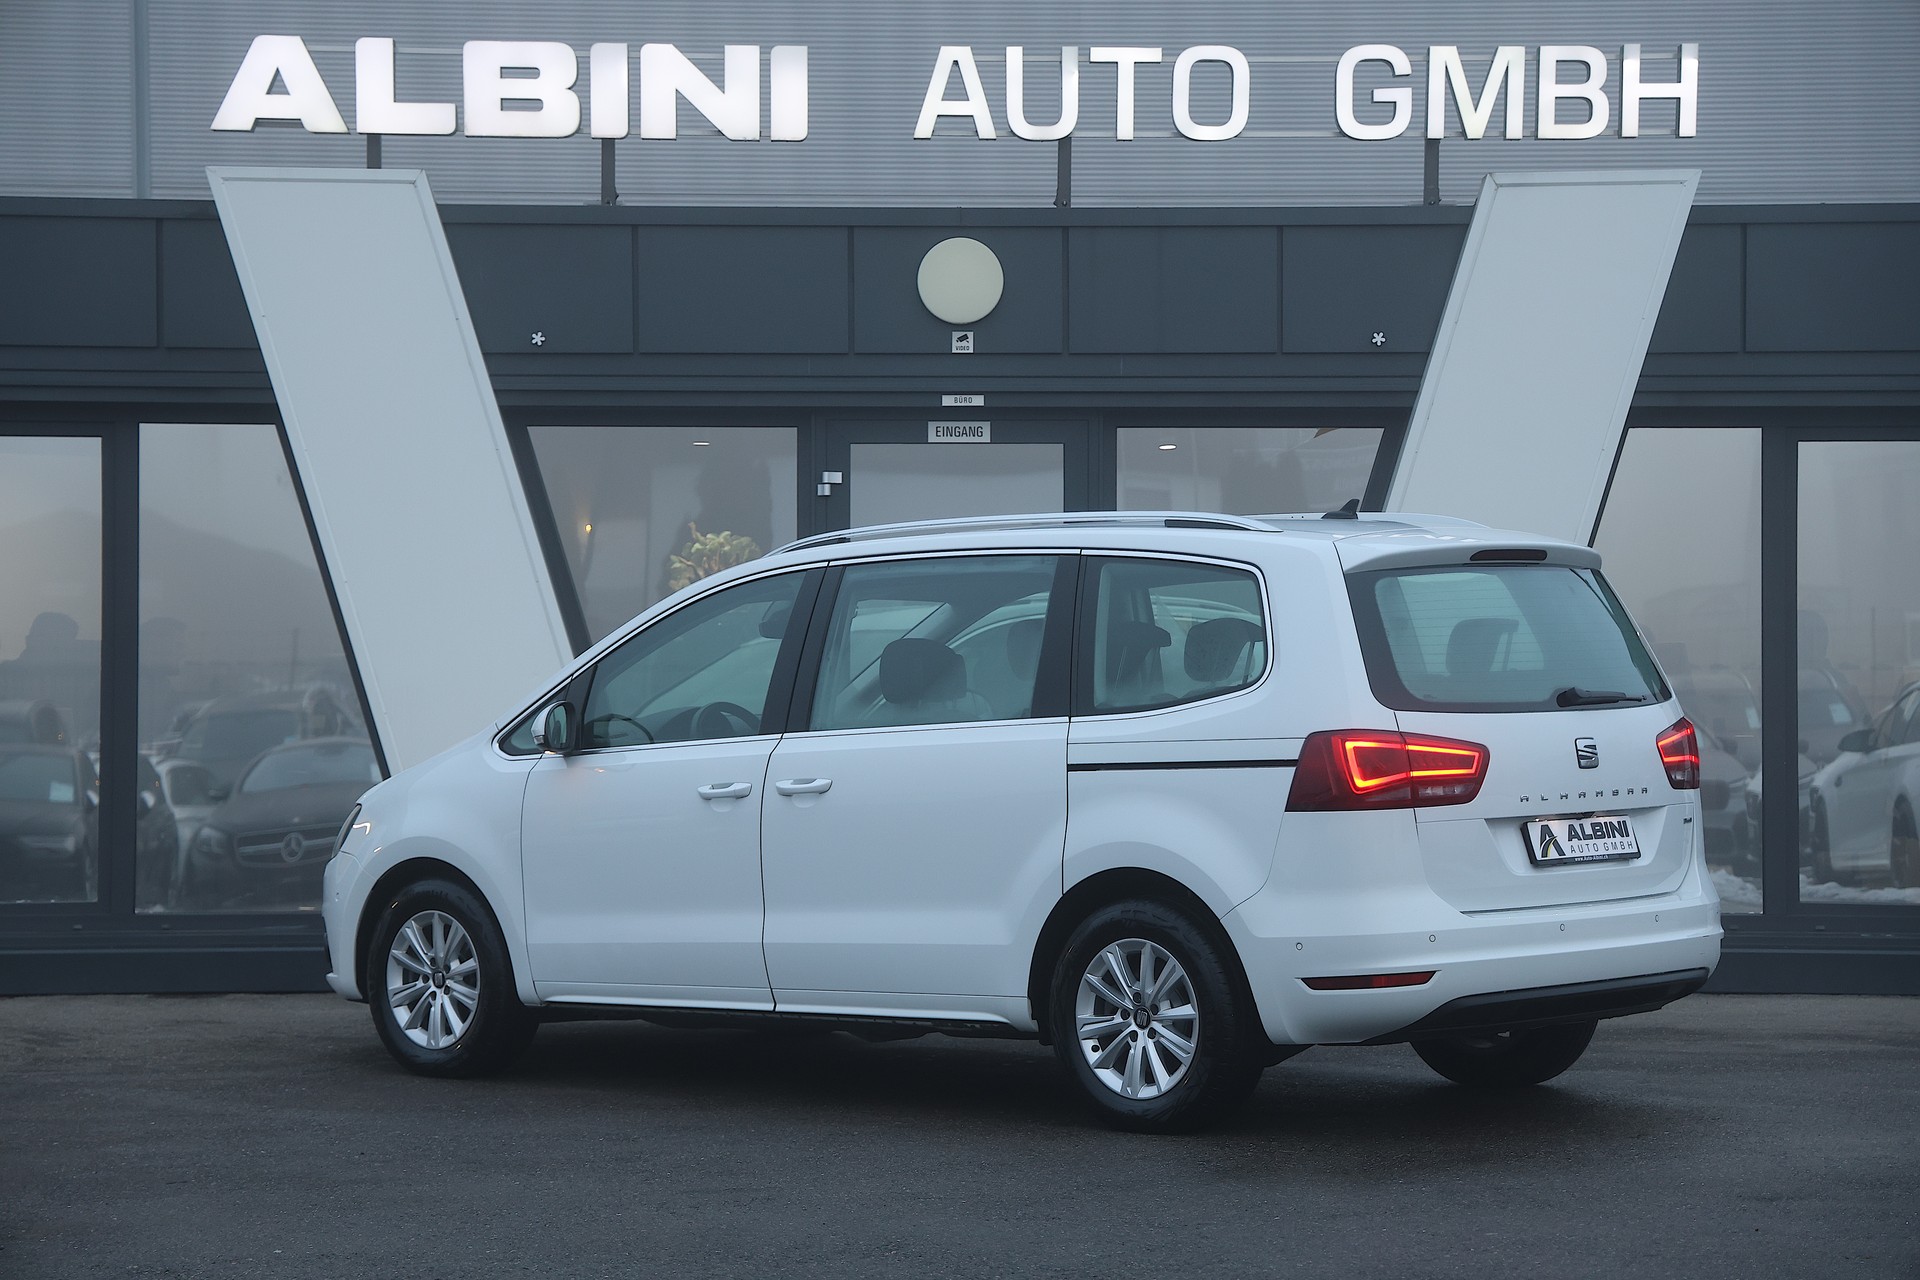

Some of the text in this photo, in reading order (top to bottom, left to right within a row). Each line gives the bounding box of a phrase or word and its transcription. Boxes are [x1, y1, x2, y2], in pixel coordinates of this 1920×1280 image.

[210, 34, 1699, 142] ALBINI AUTO GMBH
[954, 396, 973, 404] BÜRO
[935, 426, 984, 438] EINGANG
[1520, 787, 1648, 802] ALHAMBRA
[1567, 820, 1630, 842] ALBINI
[1570, 840, 1634, 854] AUTO GMBH
